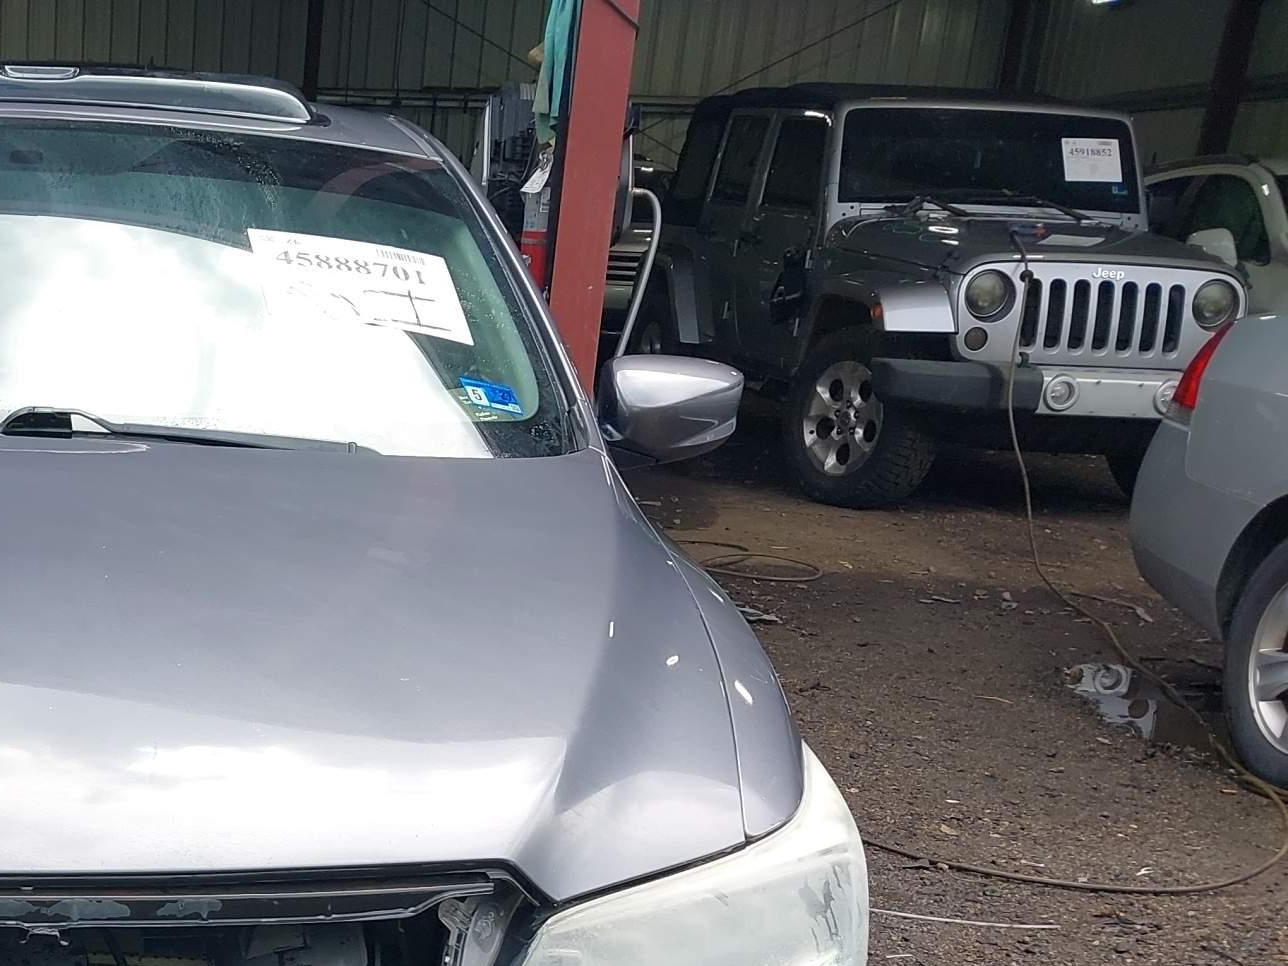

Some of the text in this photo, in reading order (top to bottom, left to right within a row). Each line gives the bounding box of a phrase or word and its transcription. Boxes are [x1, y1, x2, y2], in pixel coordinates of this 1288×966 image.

[276, 250, 426, 284] 45888701
[1092, 267, 1125, 280] Jeep
[471, 389, 482, 401] 5
